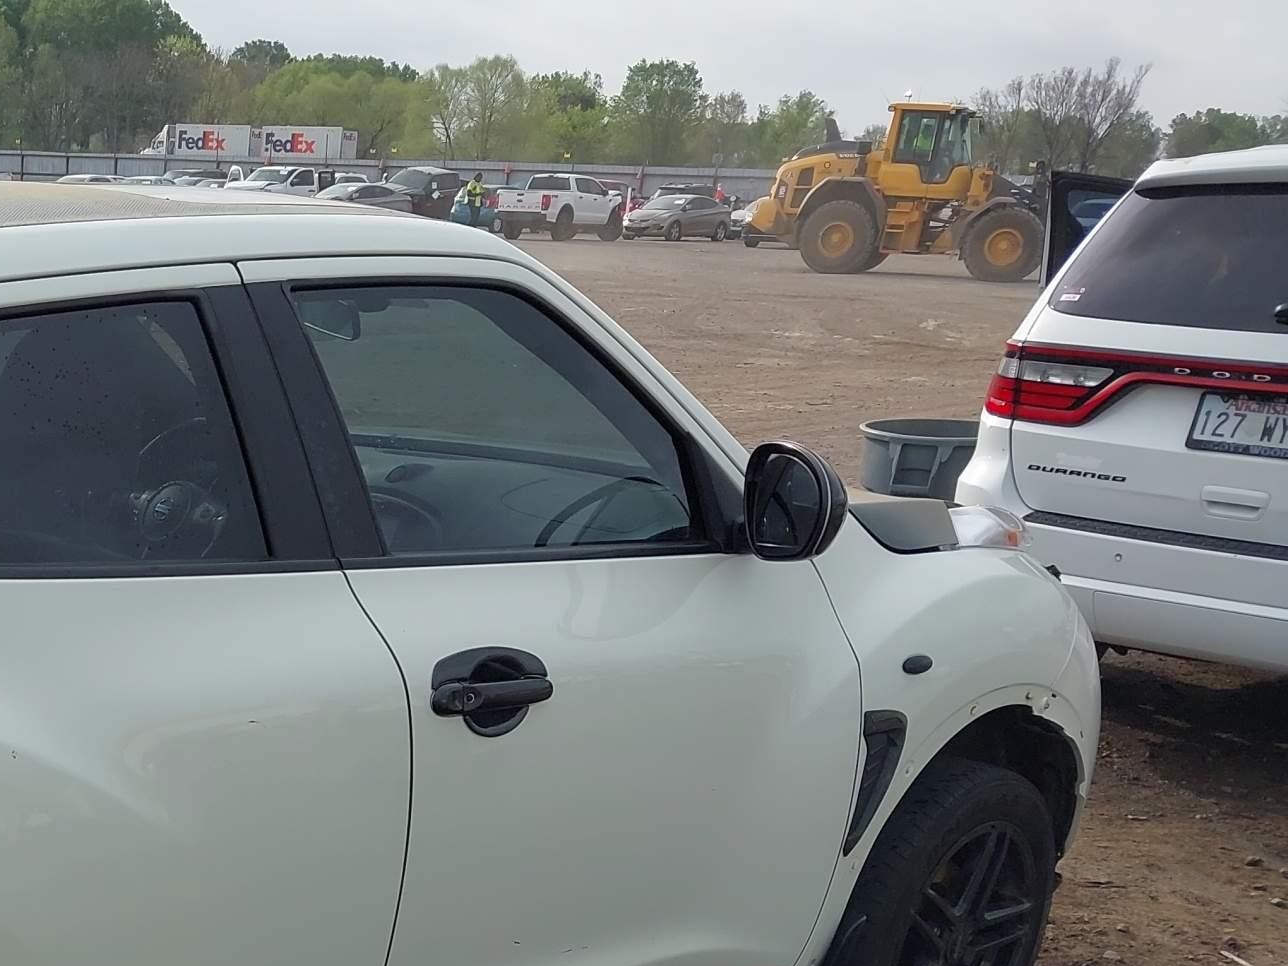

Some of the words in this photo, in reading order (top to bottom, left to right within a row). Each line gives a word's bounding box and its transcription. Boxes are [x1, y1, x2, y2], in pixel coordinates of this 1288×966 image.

[177, 129, 226, 151] FedEx
[264, 132, 315, 153] FedEx
[1199, 409, 1248, 439] 127
[1027, 464, 1128, 483] DURANGO
